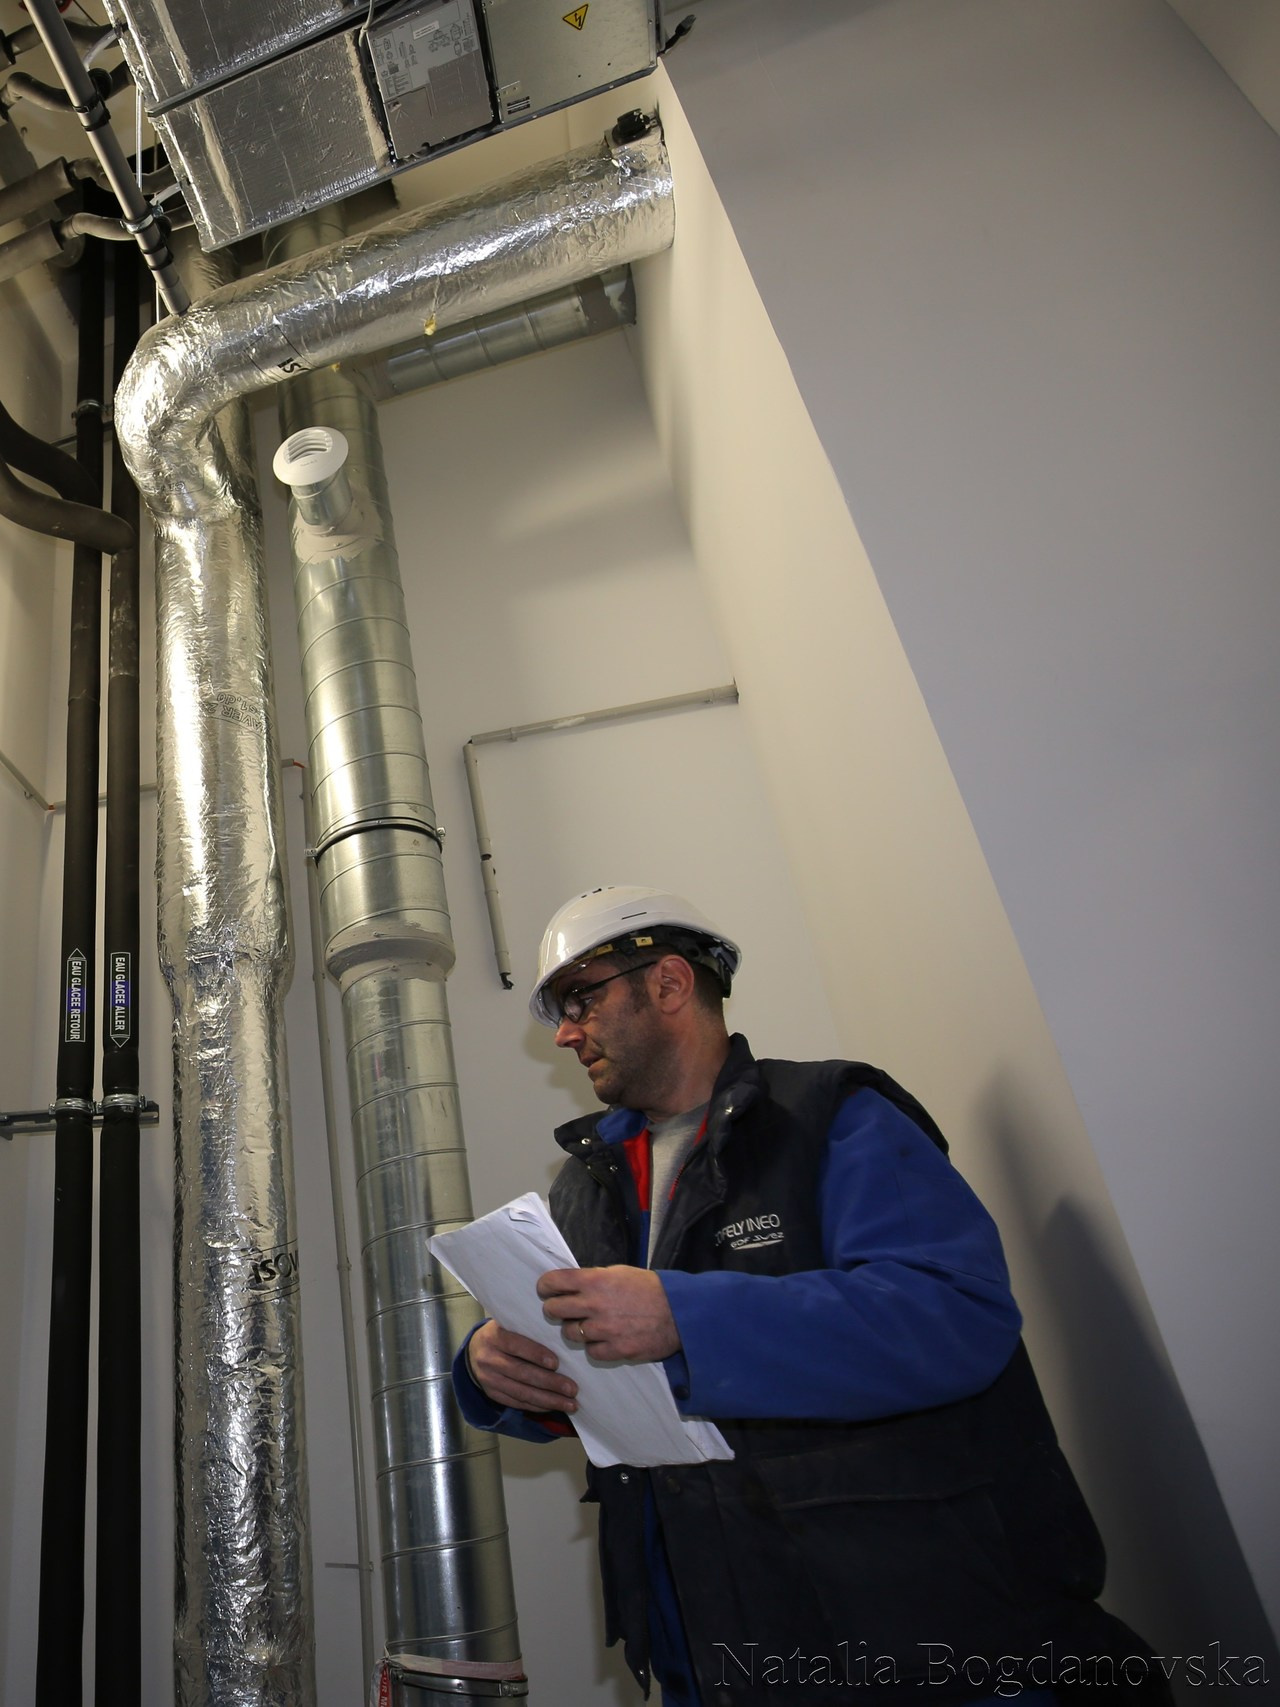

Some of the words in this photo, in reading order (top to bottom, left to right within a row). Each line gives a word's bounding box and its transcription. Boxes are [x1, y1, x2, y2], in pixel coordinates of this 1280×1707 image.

[71, 961, 82, 976] EAU
[115, 957, 126, 973] EAU
[71, 977, 81, 1007] GLACEE
[115, 974, 126, 1004] GLACEE
[70, 1008, 81, 1040] RETOUR
[115, 1005, 126, 1031] ALLER
[746, 1213, 781, 1232] INEO
